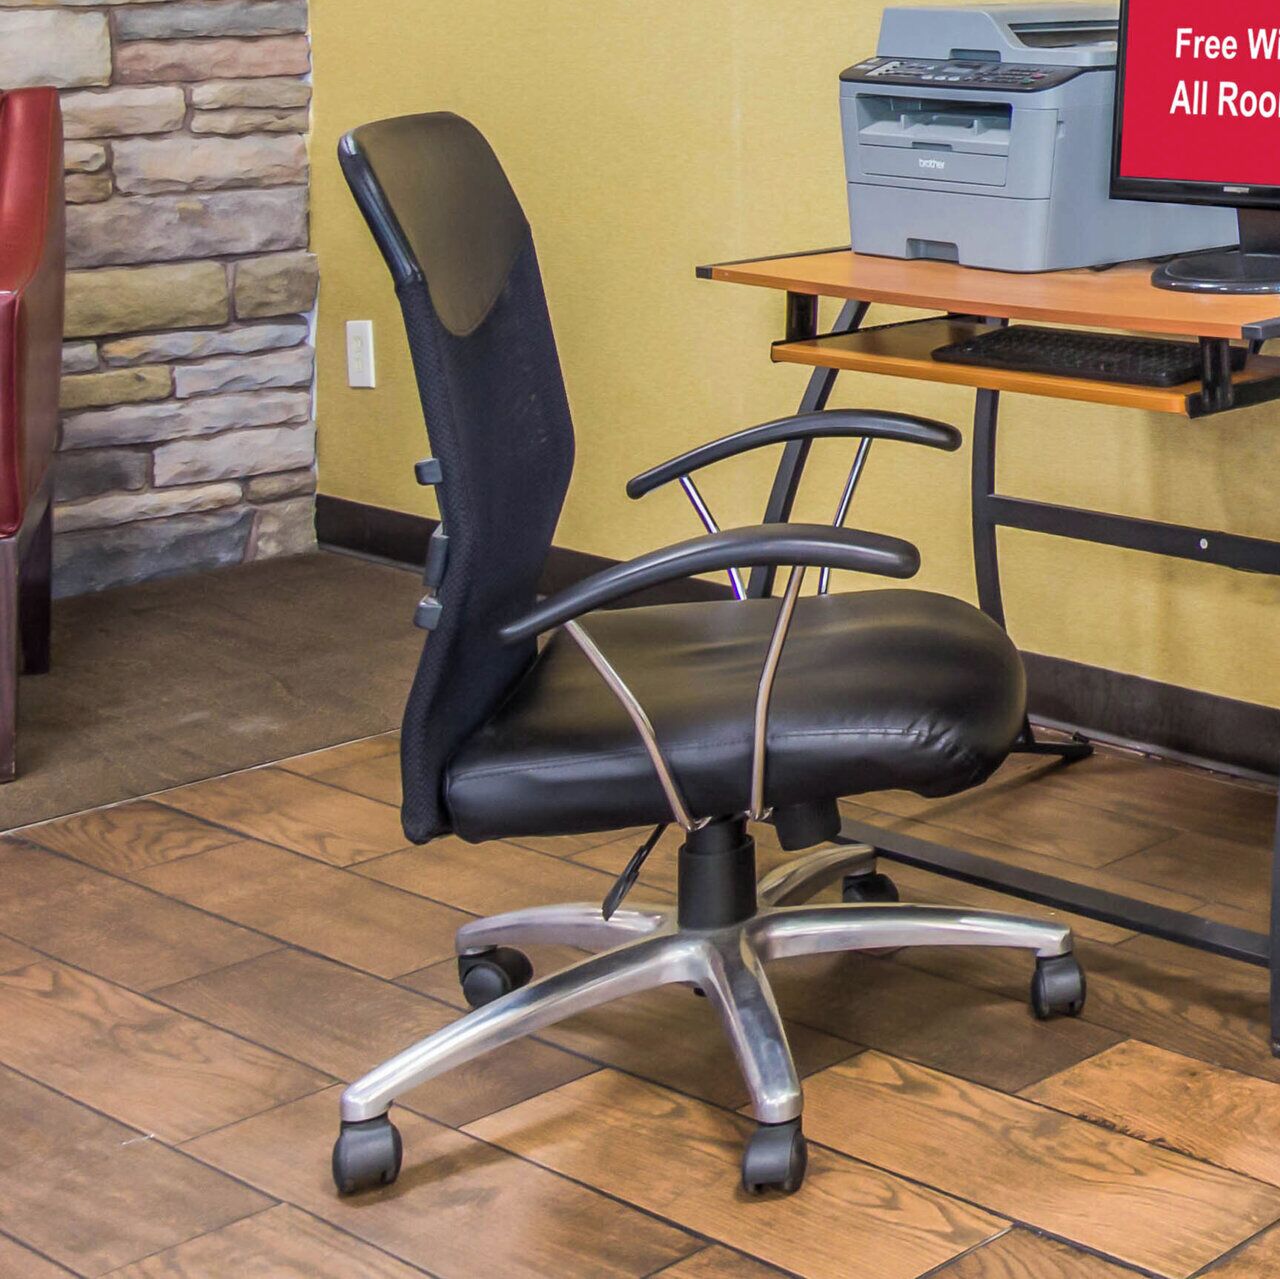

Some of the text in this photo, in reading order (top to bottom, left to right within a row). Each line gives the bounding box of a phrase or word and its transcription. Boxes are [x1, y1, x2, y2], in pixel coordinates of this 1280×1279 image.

[1175, 27, 1238, 60] Free
[1169, 80, 1208, 116] All
[918, 158, 945, 169] brother
